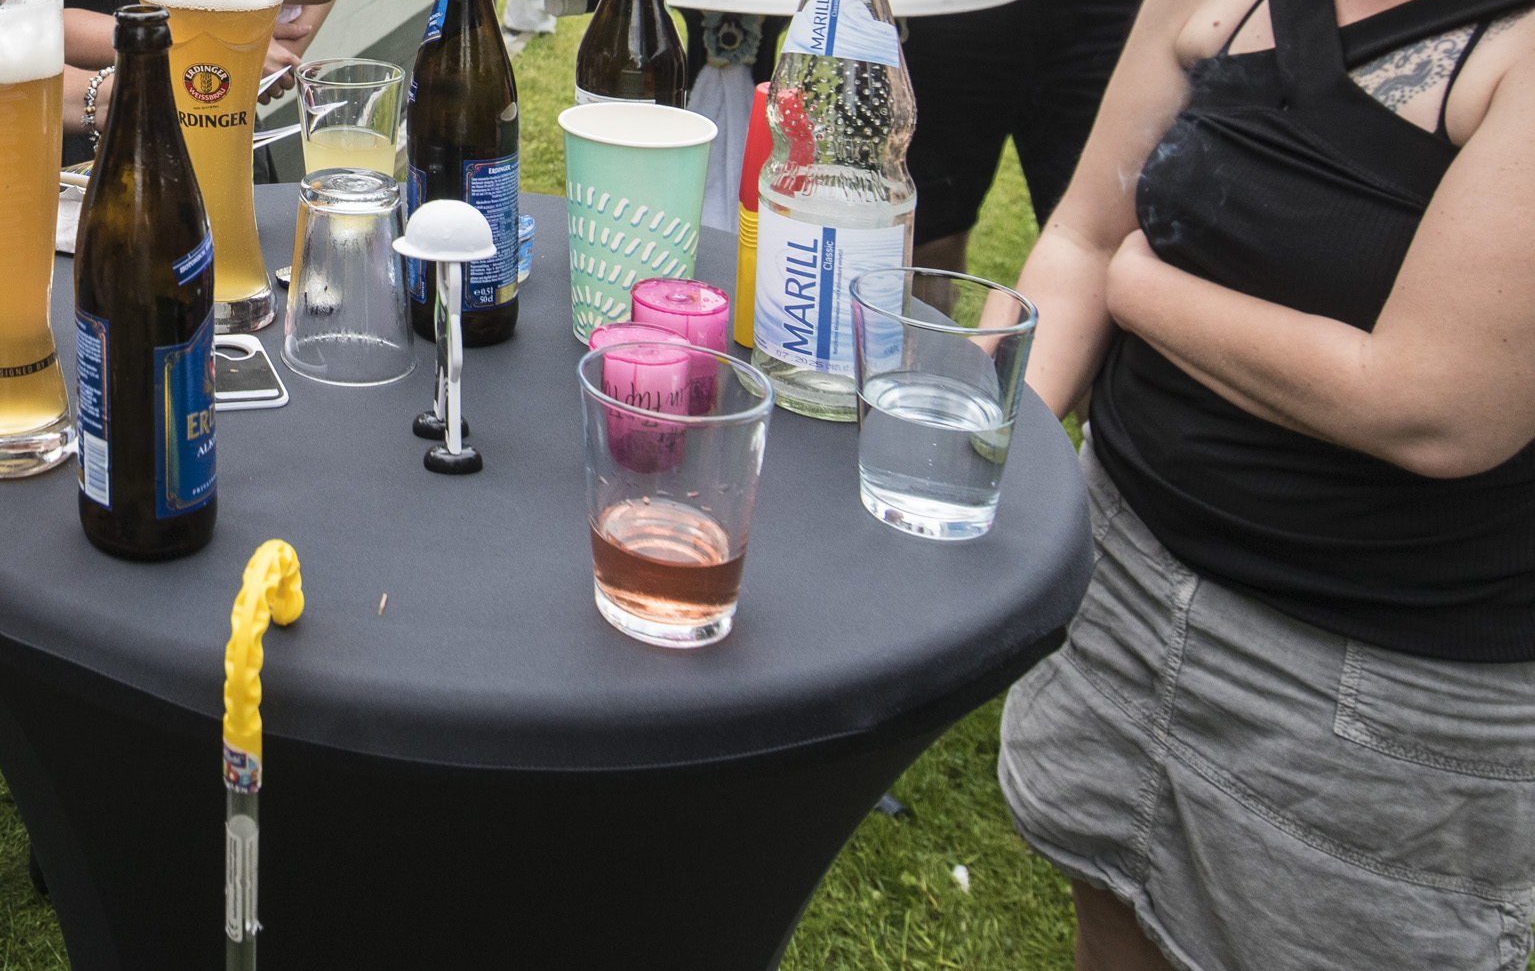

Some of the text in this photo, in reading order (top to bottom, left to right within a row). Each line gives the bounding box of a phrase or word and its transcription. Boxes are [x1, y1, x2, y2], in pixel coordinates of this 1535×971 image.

[185, 65, 227, 80] ERDINGER
[178, 110, 247, 128] RDINGER
[823, 240, 834, 271] Classic
[782, 239, 819, 356] MARILL
[36, 361, 45, 370] BY
[187, 403, 215, 440] ERD
